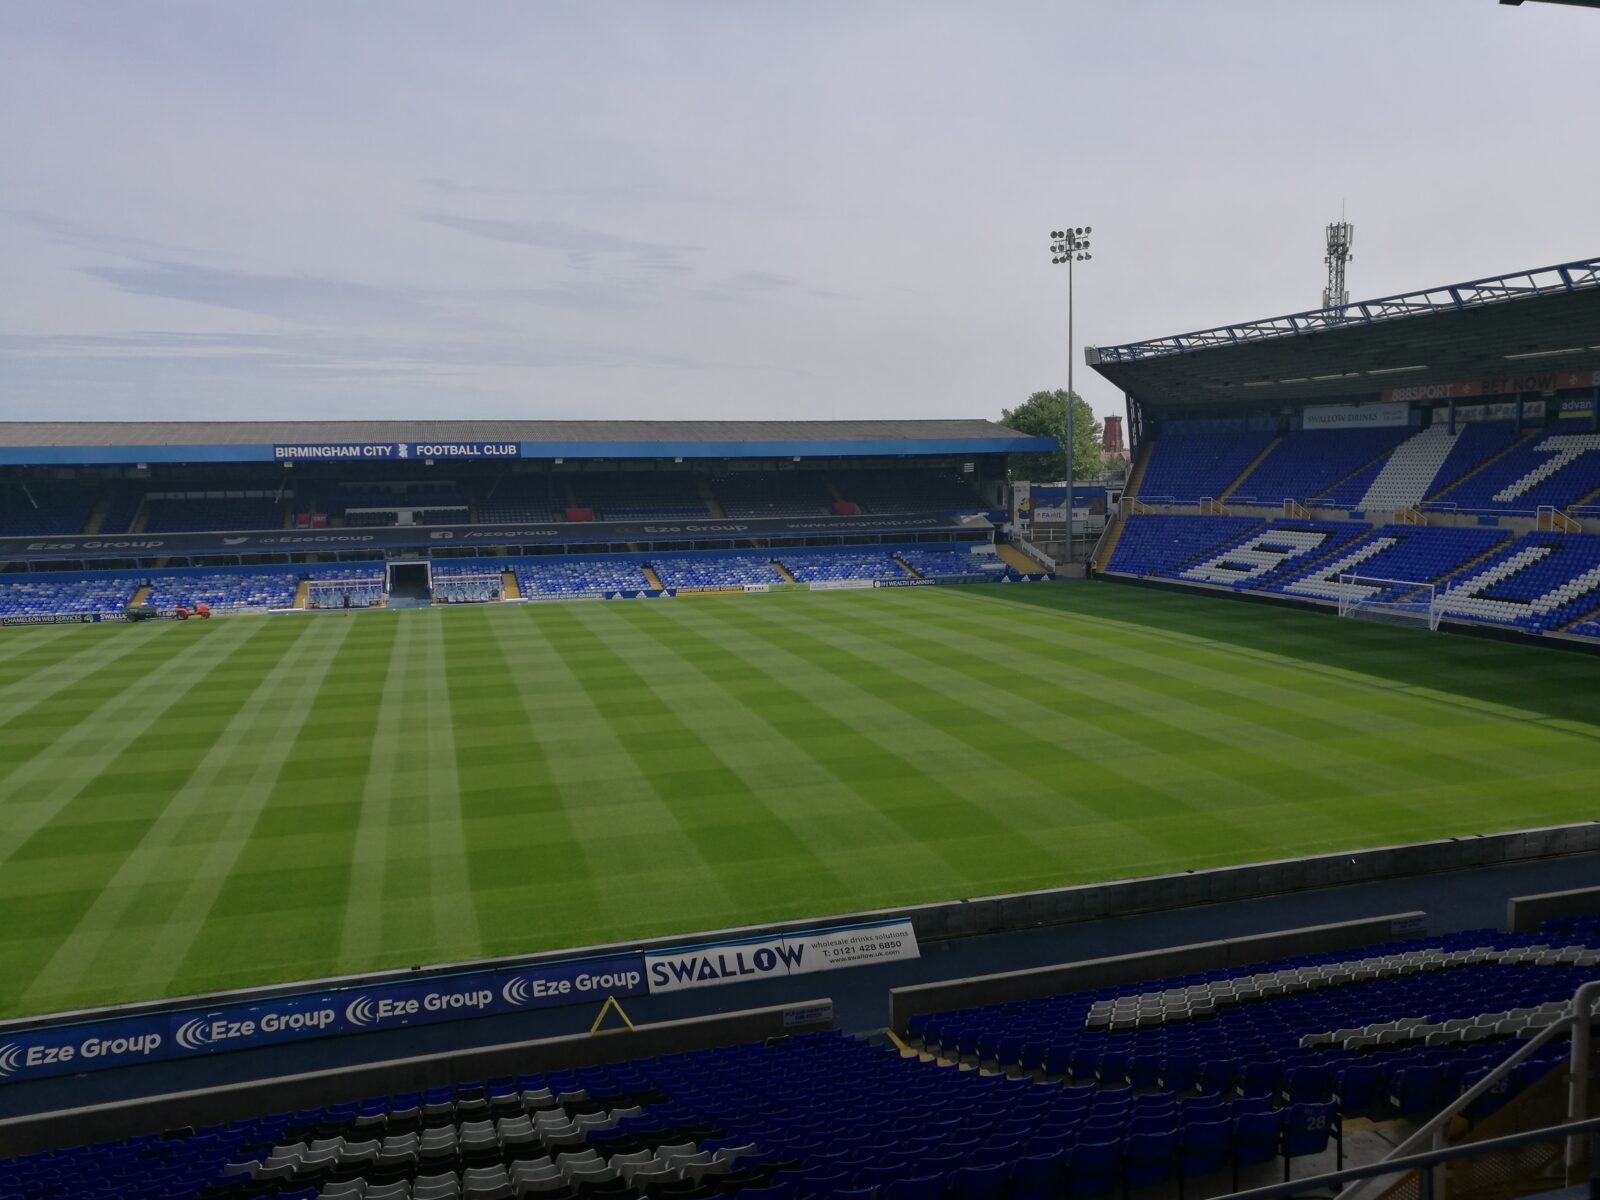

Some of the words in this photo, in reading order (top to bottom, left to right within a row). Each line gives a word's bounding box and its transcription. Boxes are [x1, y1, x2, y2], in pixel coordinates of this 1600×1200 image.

[1481, 379, 1508, 393] BET
[1513, 374, 1557, 391] NOW!
[1392, 384, 1453, 401] 888SPORT
[1307, 415, 1345, 424] SWALLOW
[1348, 413, 1378, 422] DRINKS
[275, 446, 360, 457] BIRMINGHAM
[363, 446, 393, 456] CITY
[416, 445, 481, 455] FOOTBALL
[484, 444, 517, 455] CLUB
[686, 525, 749, 533] Group
[27, 542, 75, 550] Eze
[82, 540, 164, 550] Group
[259, 535, 375, 544] @EzeGroup
[3, 616, 42, 624] CHAMELEON
[811, 939, 848, 950] wholesale
[850, 935, 874, 945] drinks
[875, 930, 909, 941] solutions
[822, 950, 831, 958] T:
[833, 947, 857, 957] 0121
[859, 943, 878, 953] 428
[879, 940, 902, 951] 6850
[830, 950, 901, 965] www.swallow.uk.com
[651, 943, 805, 987] SWALLOW
[532, 979, 572, 998] Eze
[576, 970, 640, 991] Group
[379, 999, 419, 1018] Eze
[423, 988, 493, 1012] Group
[211, 1019, 255, 1040] Eze
[260, 1008, 335, 1033] Group
[26, 1046, 74, 1067] Eze
[80, 1031, 162, 1059] Group
